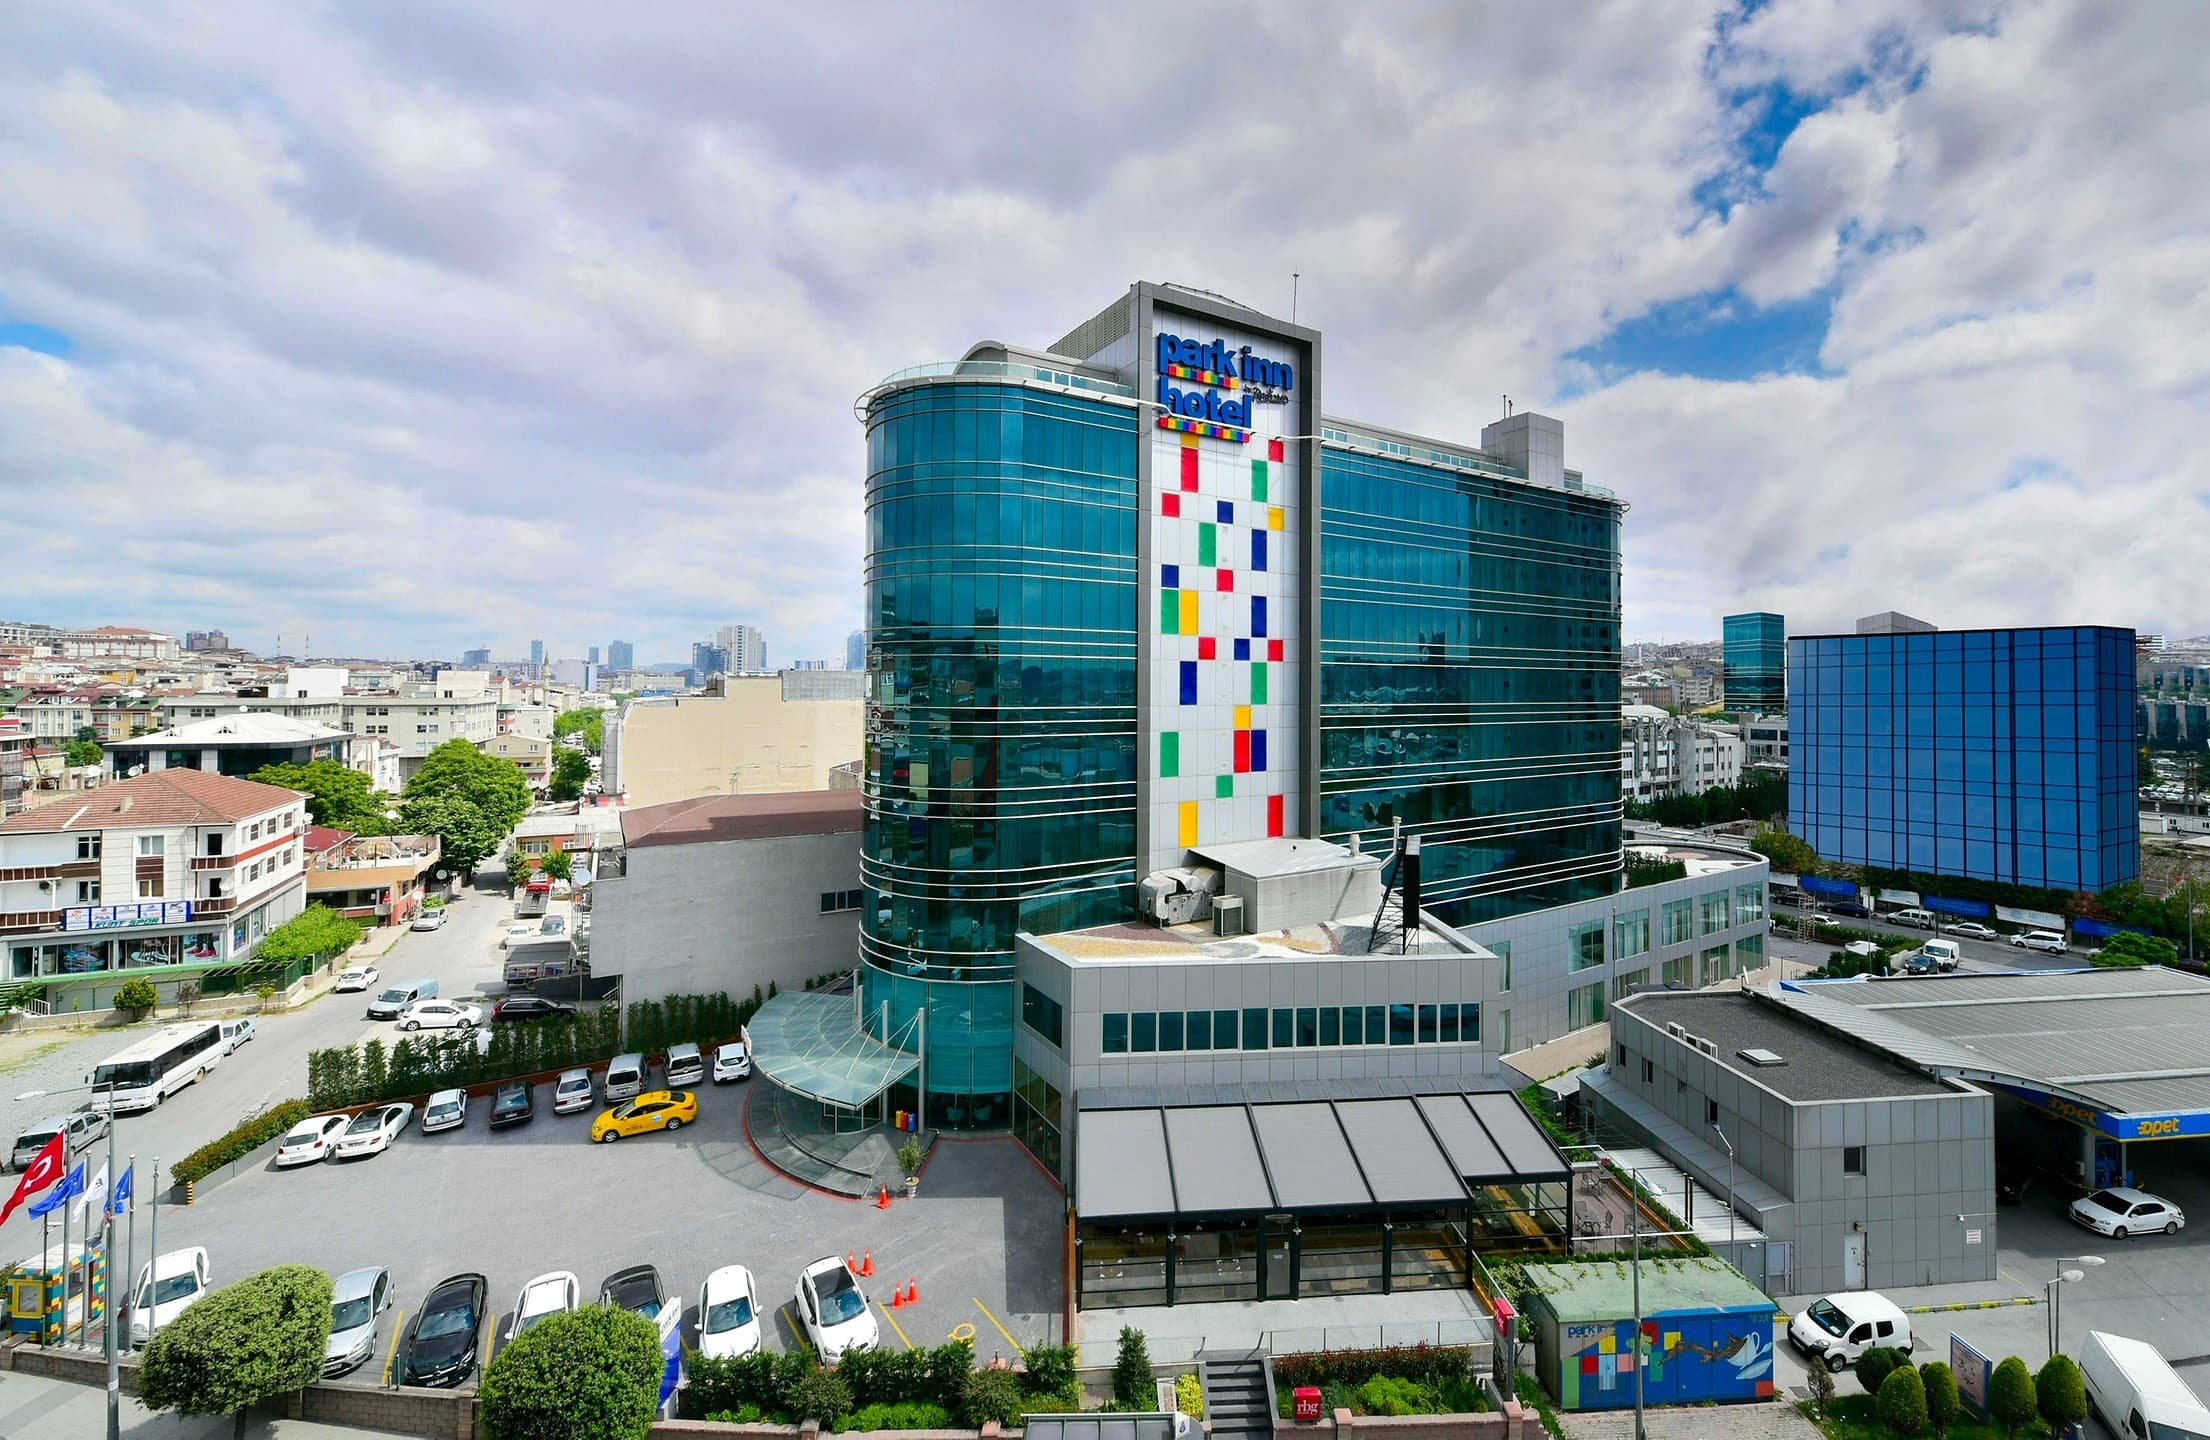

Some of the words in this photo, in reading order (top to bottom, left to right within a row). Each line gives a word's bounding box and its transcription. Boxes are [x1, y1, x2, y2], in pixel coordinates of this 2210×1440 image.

[1158, 332, 1238, 377] park
[1240, 346, 1293, 390] inn
[1158, 375, 1252, 428] hotel
[128, 917, 160, 927] SPOR
[2049, 1098, 2098, 1125] opet
[2137, 1117, 2180, 1136] opet
[1568, 1325, 1596, 1338] park
[1297, 1400, 1319, 1415] rbg
